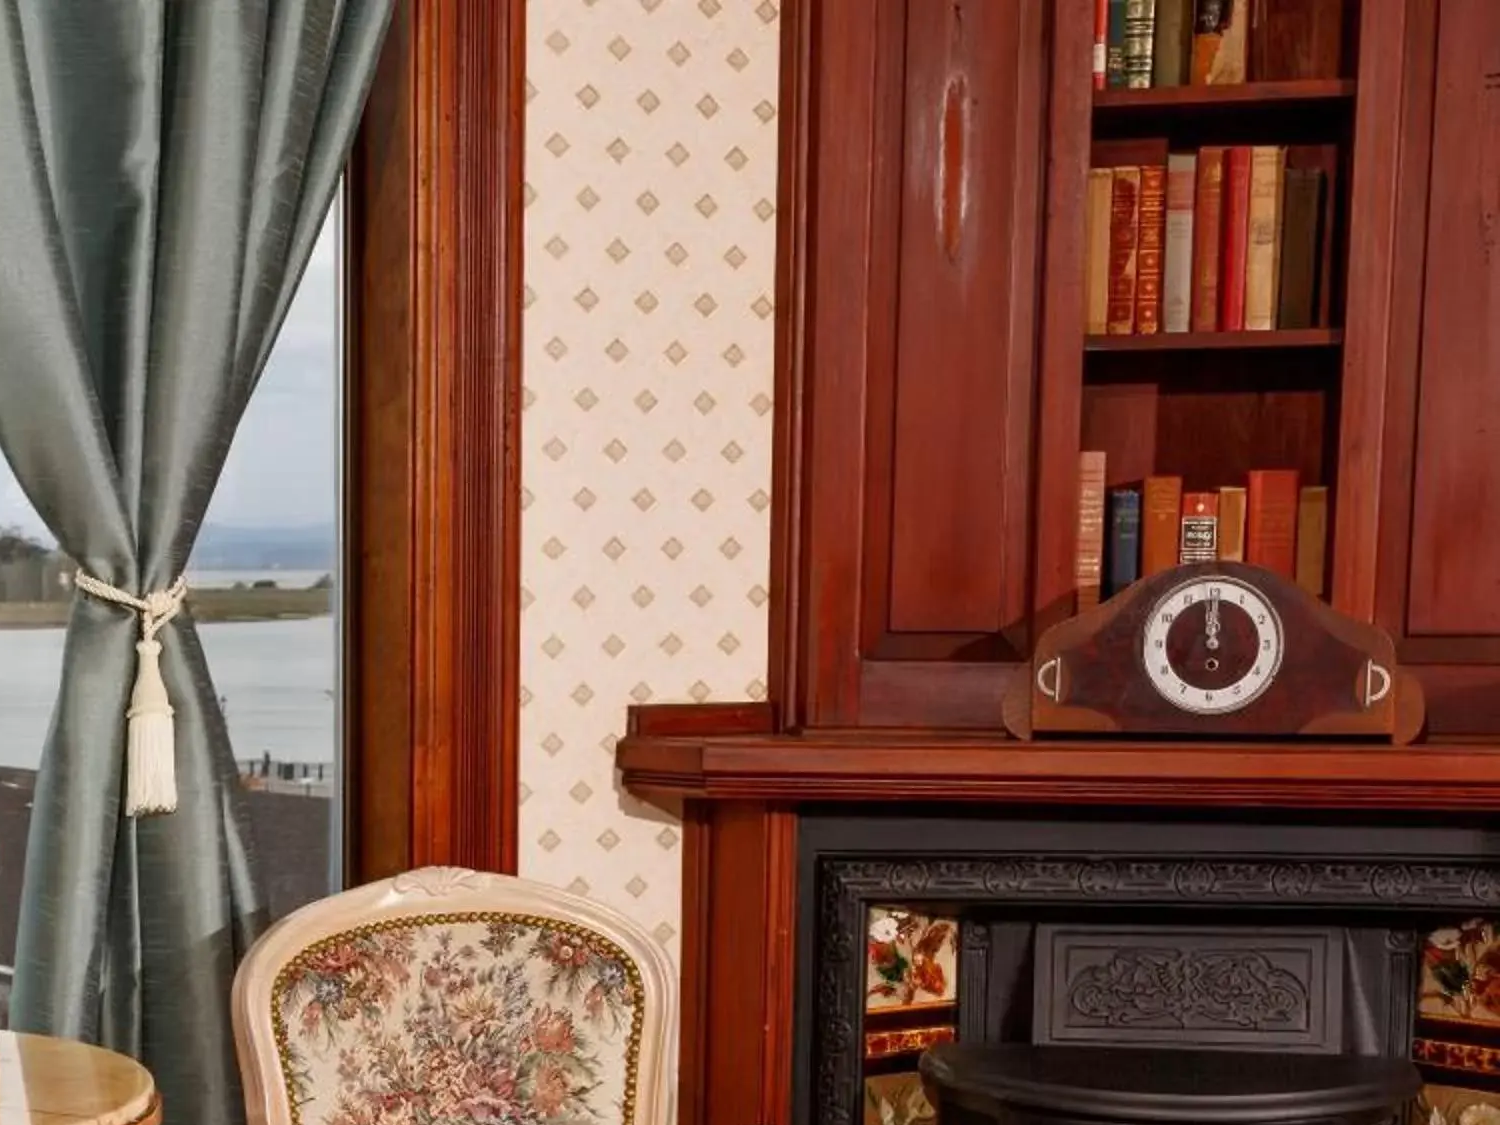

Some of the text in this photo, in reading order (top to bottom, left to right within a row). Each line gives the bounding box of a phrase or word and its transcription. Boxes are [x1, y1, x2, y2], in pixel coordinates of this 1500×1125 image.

[1258, 615, 1265, 624] 2
[1155, 640, 1162, 649] 9
[1263, 640, 1271, 650] 3
[1180, 683, 1188, 694] 7
[1233, 685, 1241, 694] 5
[1205, 692, 1212, 701] 6
